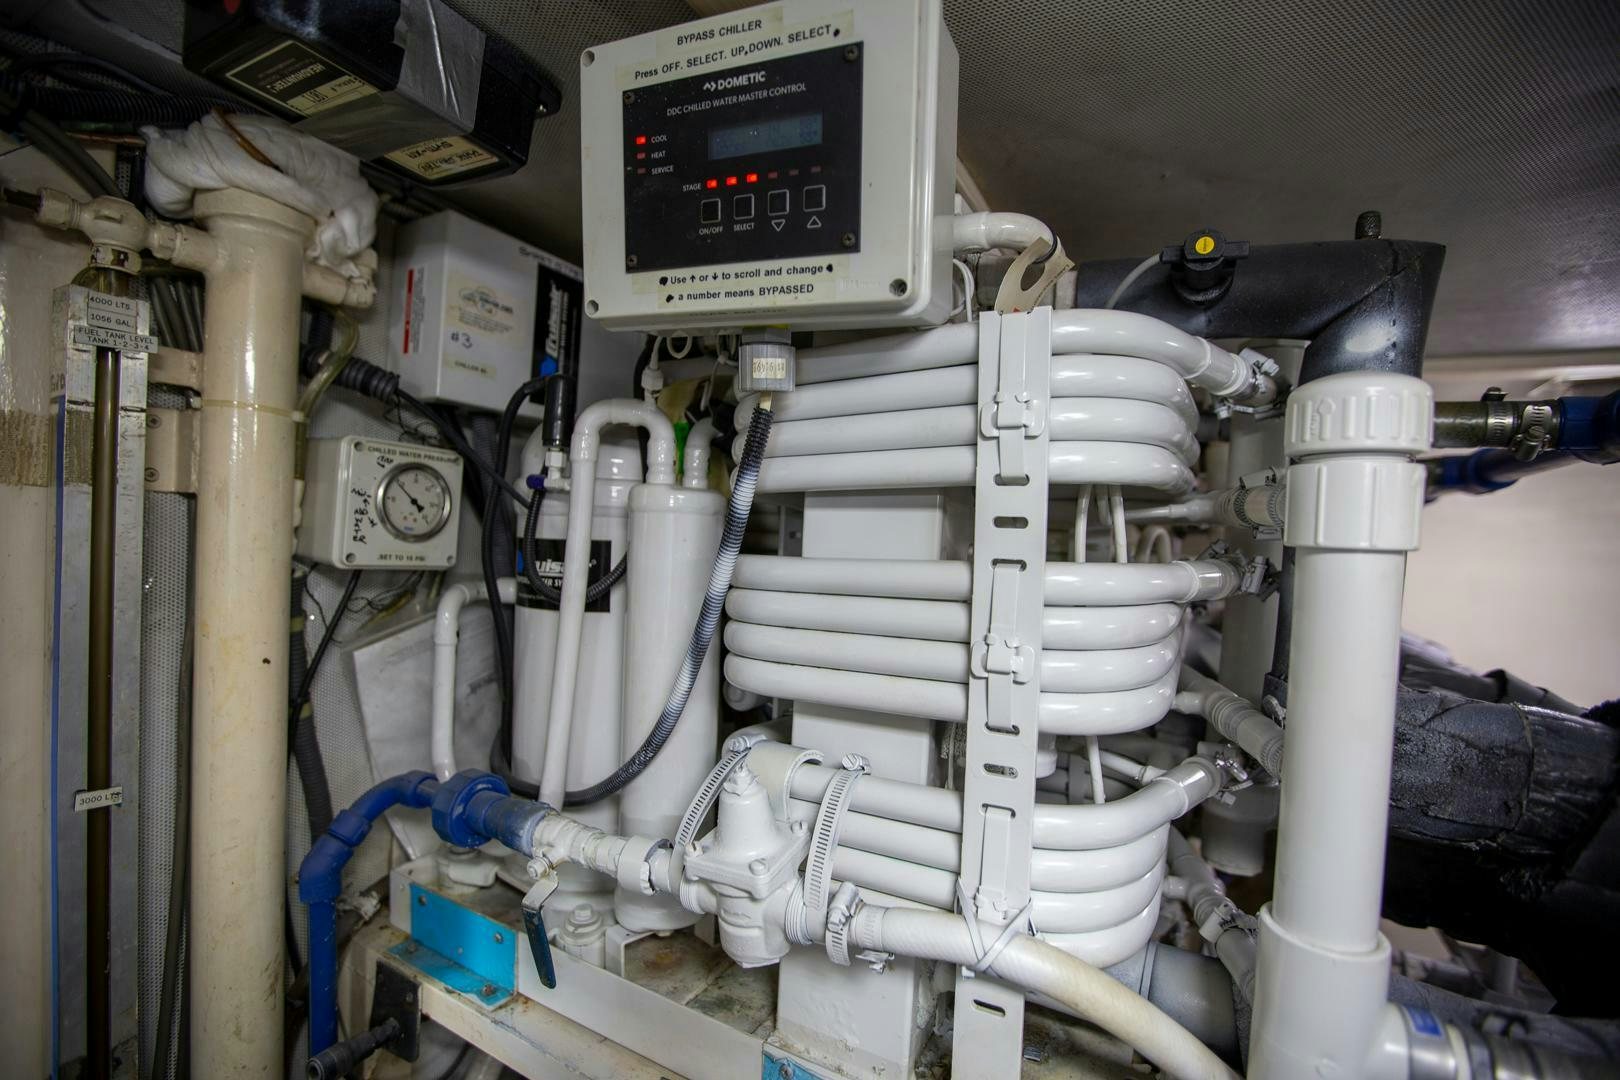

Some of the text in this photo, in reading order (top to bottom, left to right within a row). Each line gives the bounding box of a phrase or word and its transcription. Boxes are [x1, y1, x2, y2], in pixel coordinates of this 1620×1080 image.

[677, 19, 763, 46] BYPASS CHILLER
[635, 68, 659, 80] Press
[661, 61, 684, 74] OFF.
[686, 50, 727, 68] SELECT.
[717, 71, 767, 90] DOMETIC
[666, 82, 806, 117] DDC CHILLED WATER MASTER CONTROL
[651, 135, 668, 143] COOL
[651, 151, 666, 159] HEAT
[651, 165, 674, 175] SERVICE
[682, 183, 701, 192] STAGE
[698, 222, 755, 236] ON/OFF SELECT
[670, 274, 687, 285] Use
[721, 271, 731, 280] to
[734, 268, 761, 279] scroll
[764, 267, 783, 276] and
[786, 264, 824, 276] change
[686, 289, 722, 301] number
[724, 288, 755, 298] means
[758, 283, 815, 297] BYPASSED
[89, 296, 131, 310] 4000 LTS
[90, 313, 112, 323] 1056
[78, 327, 154, 345] FUEL TANK LEVEL
[88, 336, 109, 345] TANK
[368, 446, 397, 455] CHILLED
[398, 450, 422, 459] WATER
[80, 796, 102, 805] 3000
